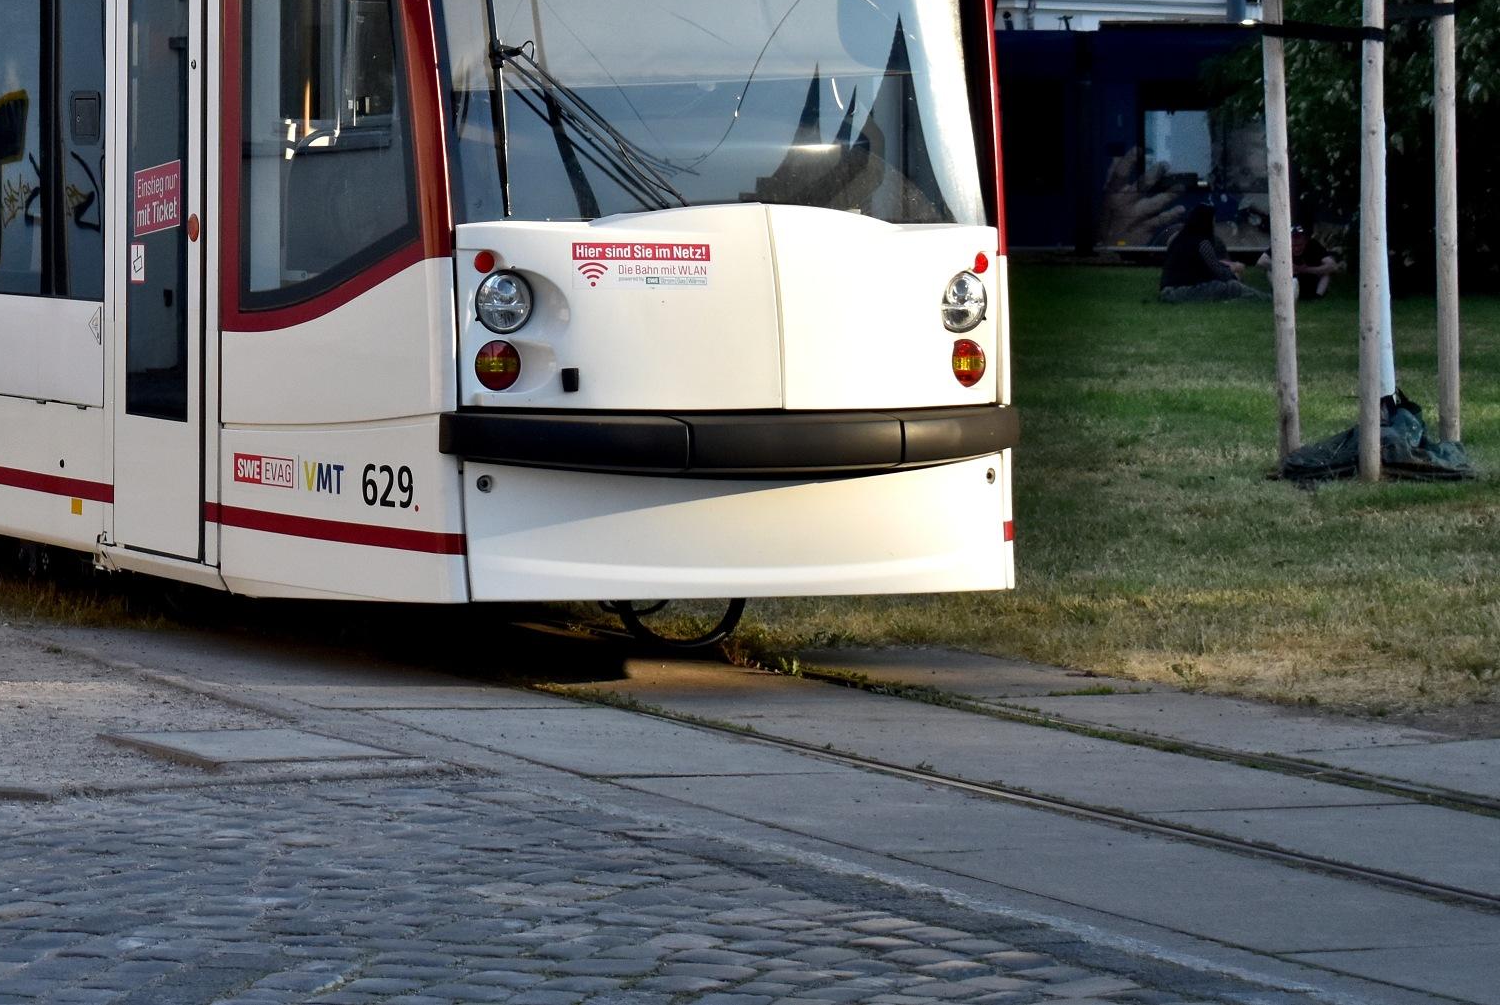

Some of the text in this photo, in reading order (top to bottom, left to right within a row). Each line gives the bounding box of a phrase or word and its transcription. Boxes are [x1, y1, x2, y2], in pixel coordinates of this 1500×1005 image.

[137, 173, 178, 198] Einstieg nur
[137, 196, 178, 227] mit Ticket
[576, 245, 706, 259] Hier sind Sie im Netz!
[618, 264, 707, 276] Die Bahn mit WLAN
[238, 458, 344, 495] SWE EVAG VMT
